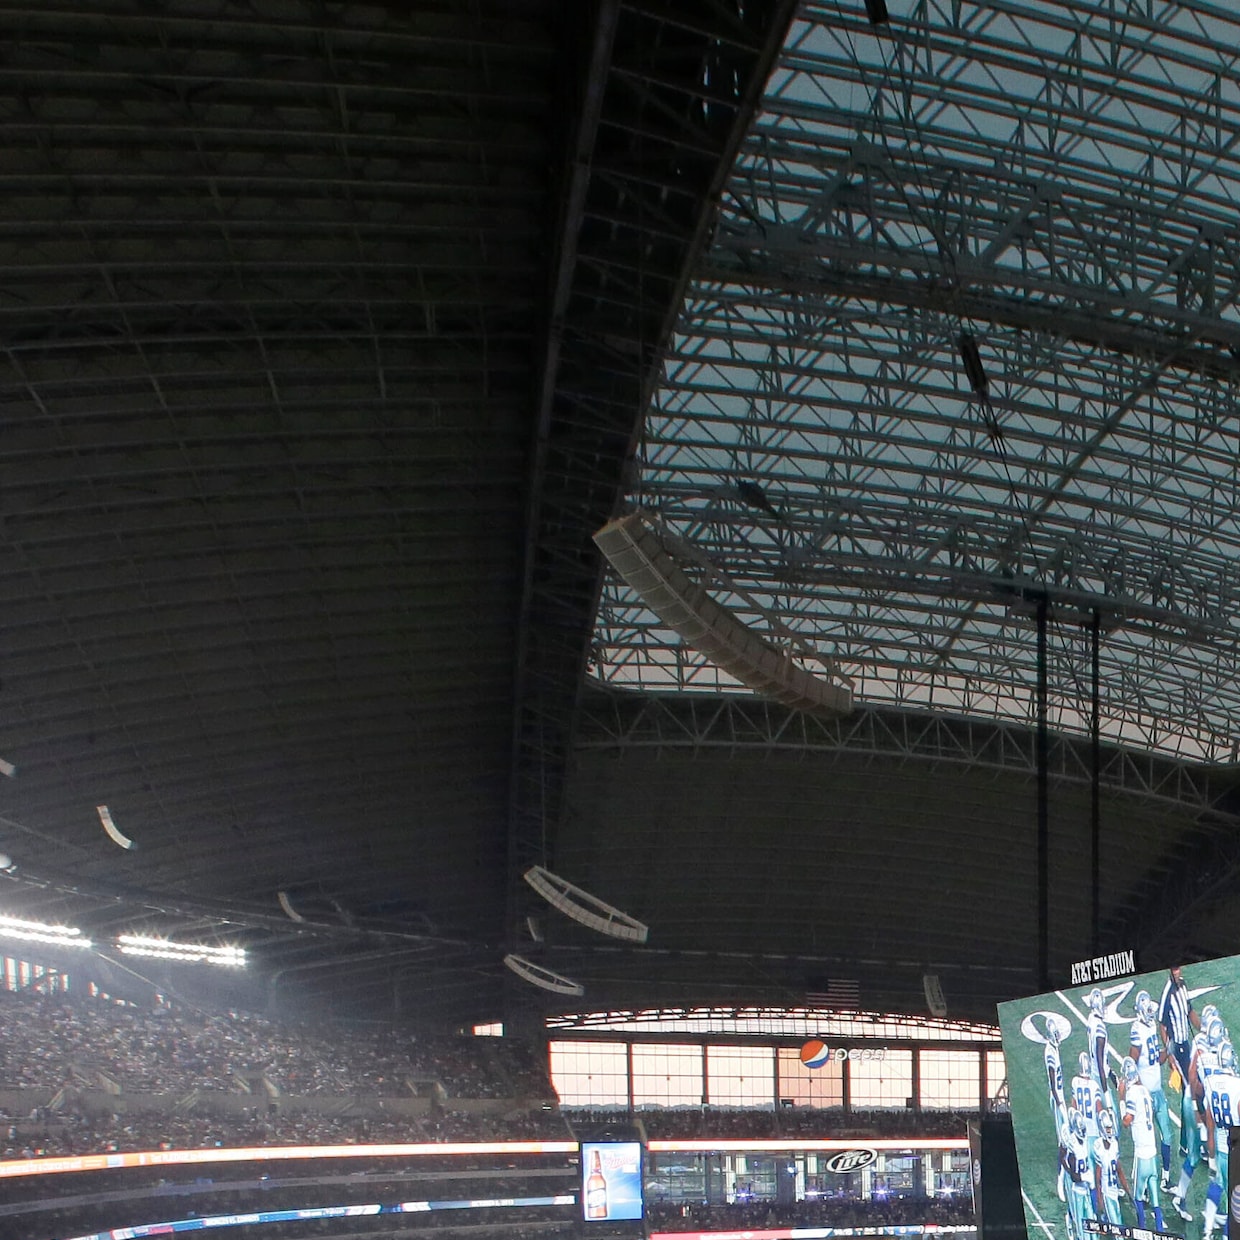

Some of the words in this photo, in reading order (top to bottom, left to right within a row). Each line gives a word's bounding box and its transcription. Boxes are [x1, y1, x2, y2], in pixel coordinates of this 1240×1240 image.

[1072, 960, 1091, 984] AT&T
[1092, 950, 1135, 979] STADIUM
[834, 1046, 888, 1066] pepsi
[1211, 1091, 1234, 1129] 68
